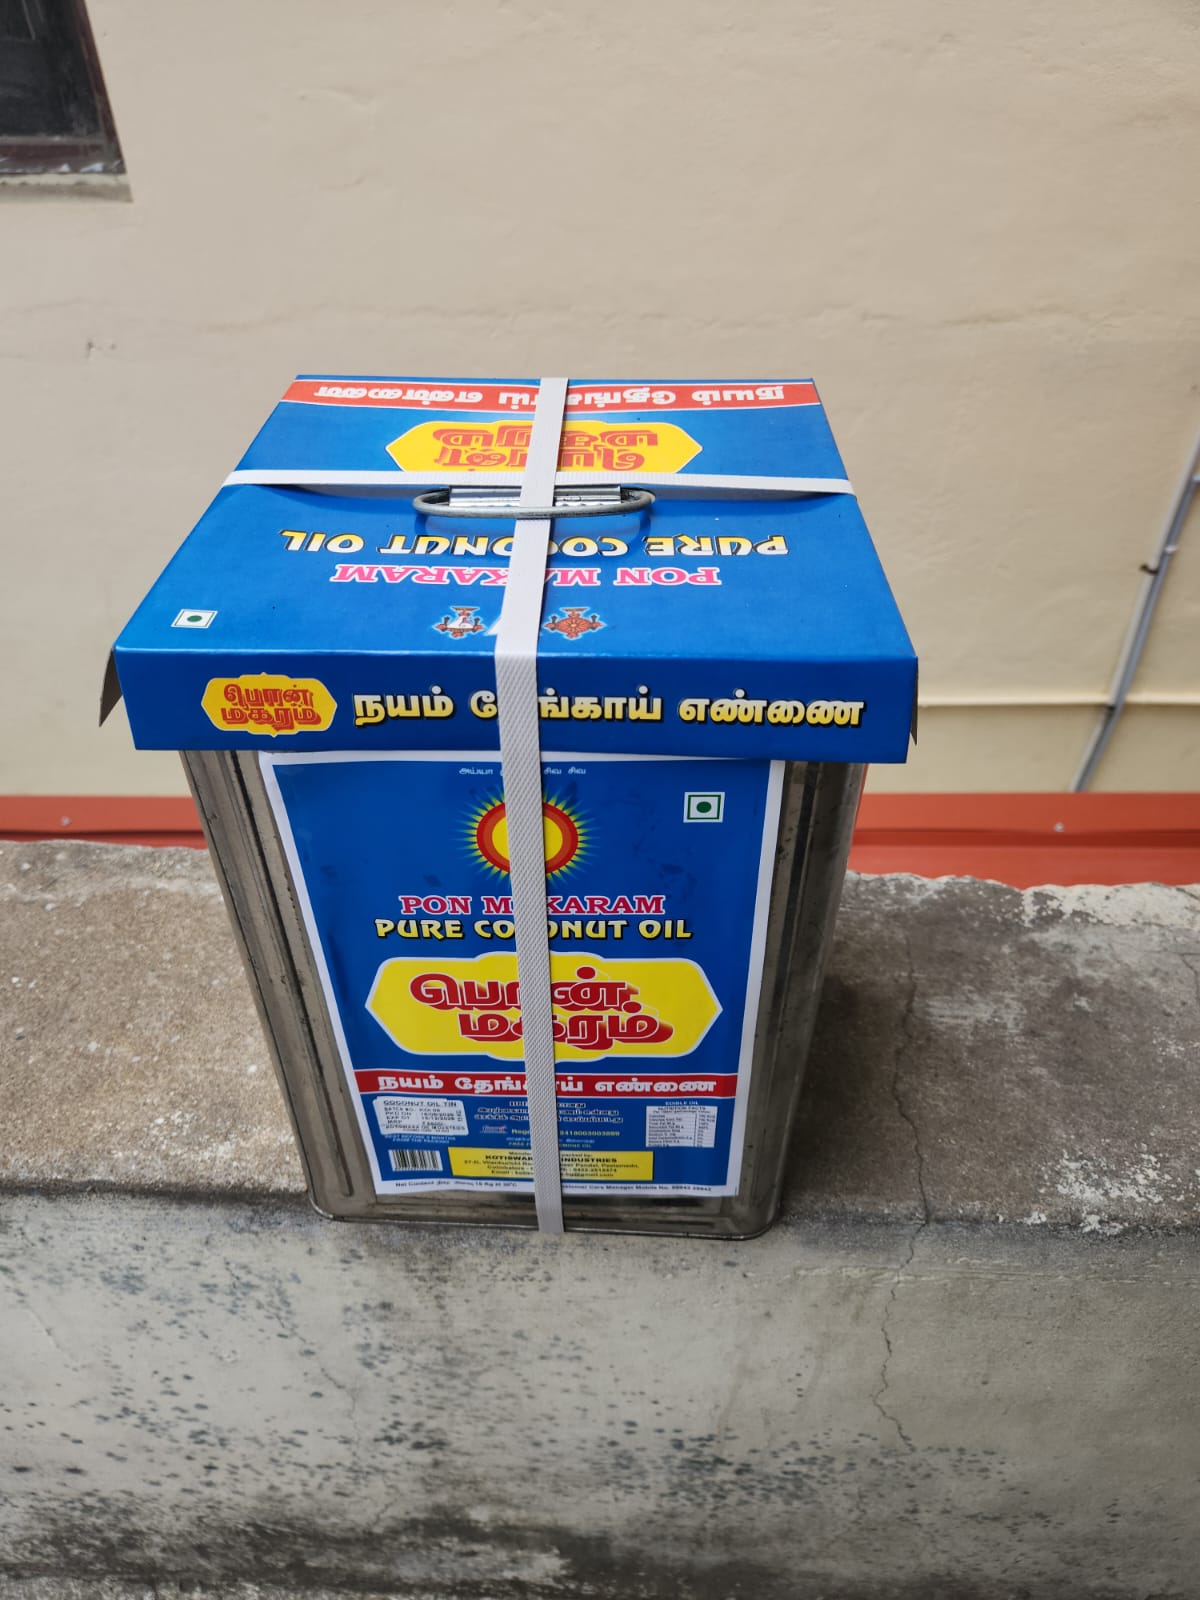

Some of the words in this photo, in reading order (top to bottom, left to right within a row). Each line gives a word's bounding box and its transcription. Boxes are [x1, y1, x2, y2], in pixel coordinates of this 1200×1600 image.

[690, 384, 785, 406] நயம்
[280, 529, 365, 554] OIL
[647, 533, 789, 557] PURE
[616, 567, 722, 586] PON
[223, 683, 314, 708] பொன்
[352, 685, 456, 727] நயம்
[469, 684, 663, 723] ேங்காய்
[220, 706, 322, 731] மகரம்
[399, 896, 472, 914] PON
[482, 895, 666, 915] MKARAM
[374, 919, 464, 940] PURE
[474, 919, 628, 940] CONUT
[638, 919, 693, 939] OIL
[377, 1075, 444, 1091] நயம்
